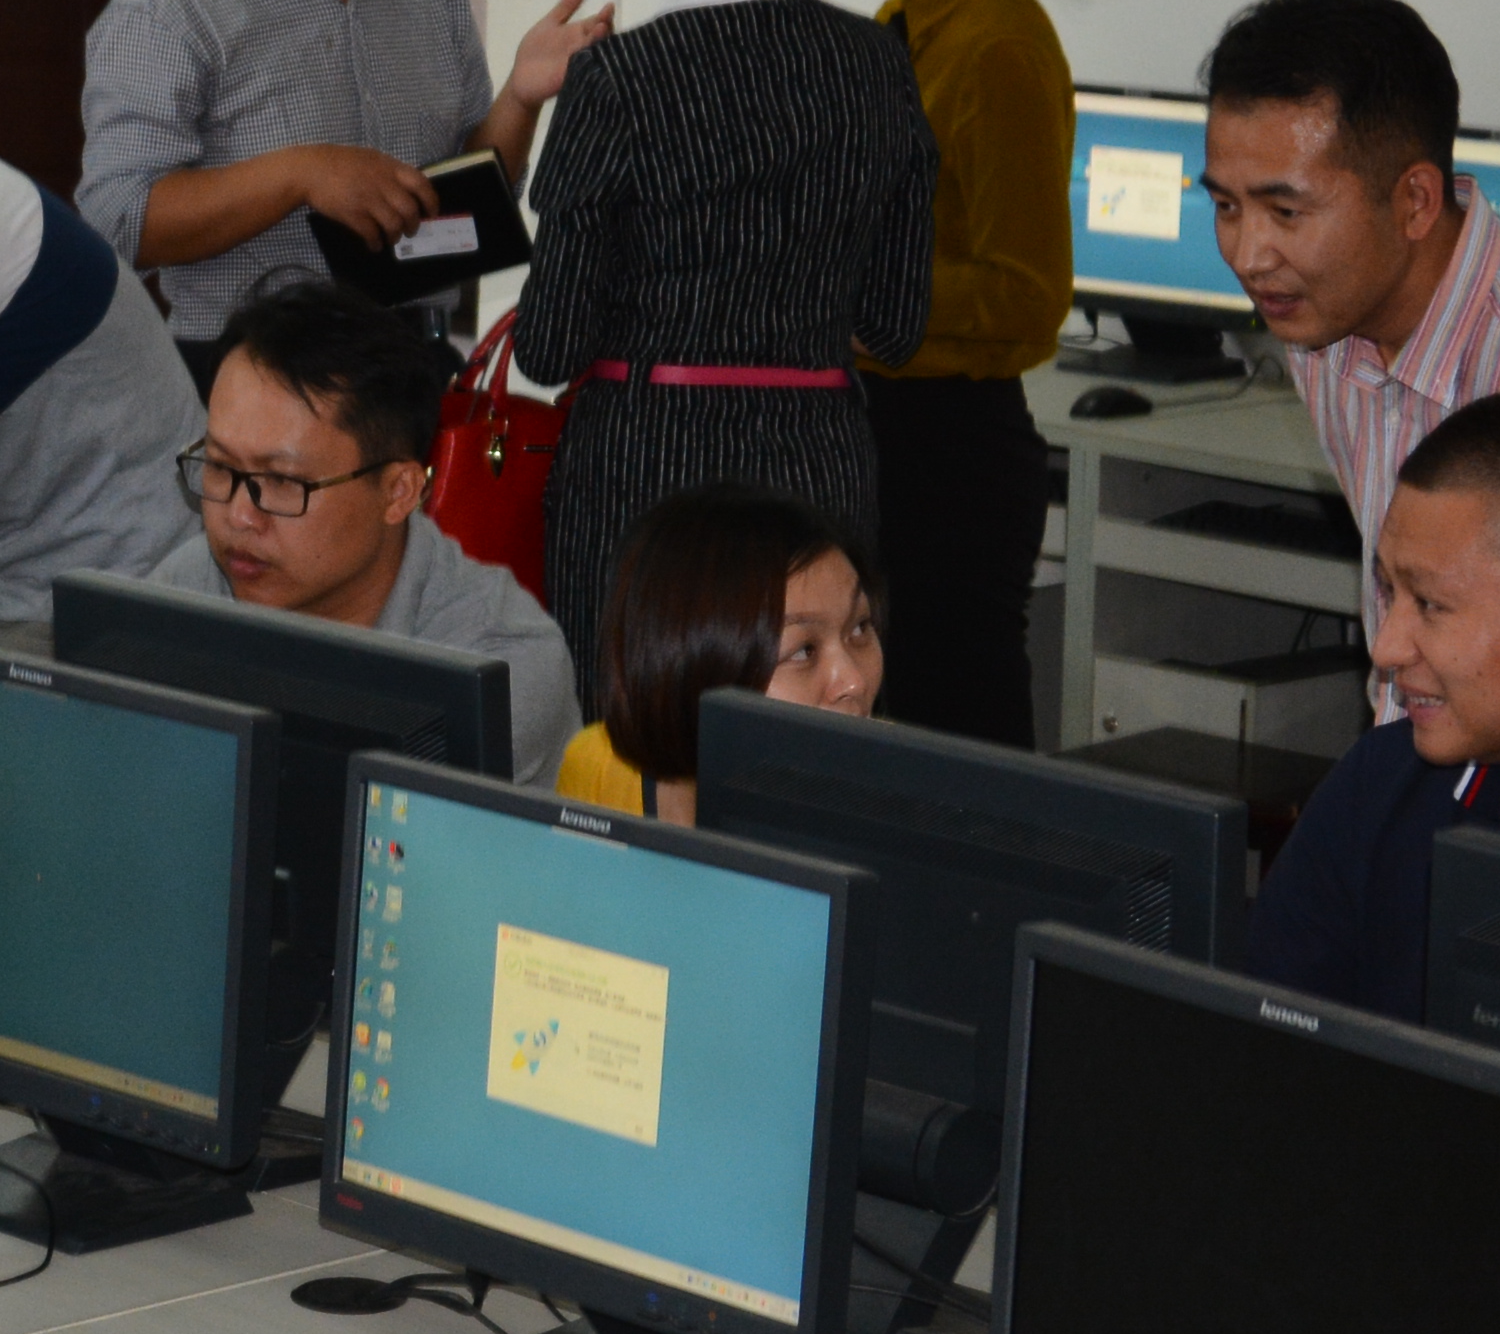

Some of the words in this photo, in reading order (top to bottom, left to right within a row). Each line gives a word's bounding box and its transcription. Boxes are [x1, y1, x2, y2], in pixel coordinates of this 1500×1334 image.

[10, 662, 52, 686] lenovo
[561, 807, 611, 835] lenovo
[1260, 998, 1319, 1032] lenovo
